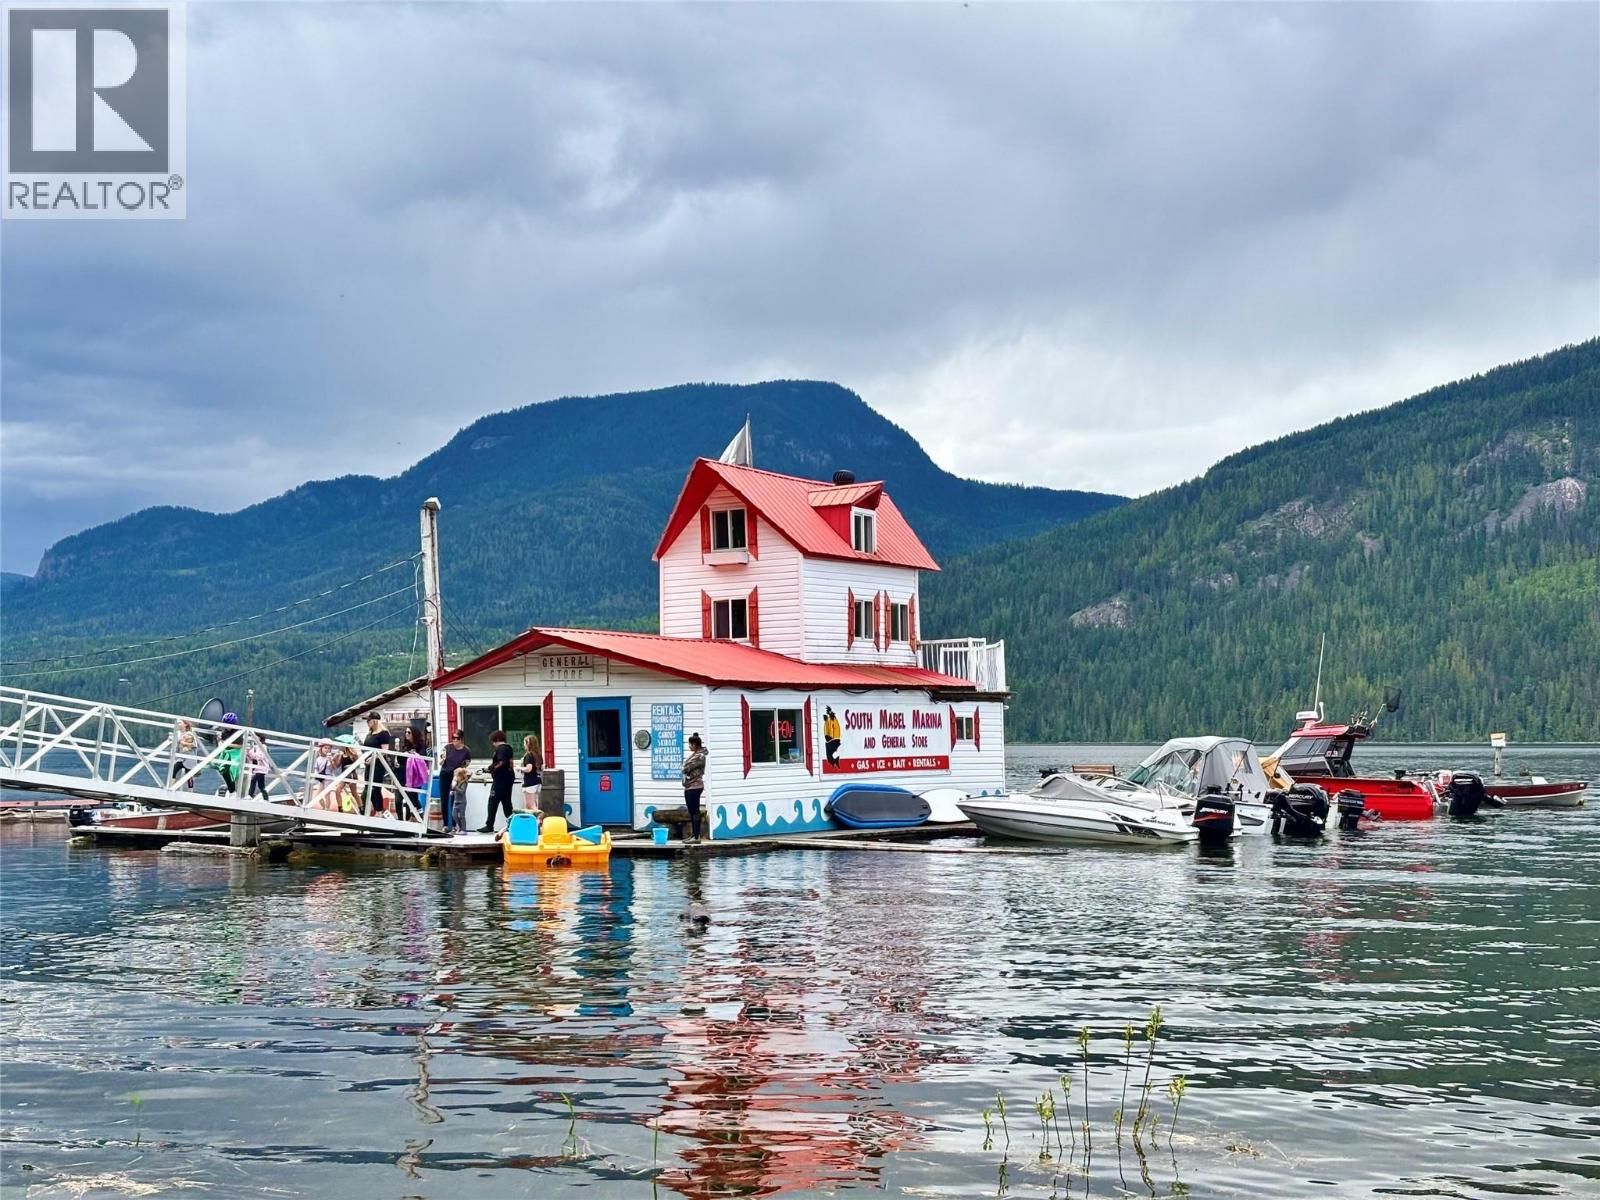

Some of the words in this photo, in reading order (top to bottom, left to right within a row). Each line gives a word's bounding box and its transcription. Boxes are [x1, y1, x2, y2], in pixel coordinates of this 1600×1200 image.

[542, 656, 590, 667] GENERAL
[550, 669, 583, 679] STORE
[652, 705, 682, 715] RENTALS
[845, 709, 872, 730] SOUTH
[880, 709, 906, 730] MABEL
[912, 709, 942, 729] MARINA
[864, 736, 875, 749] AND
[882, 735, 906, 748] GENERAL
[912, 734, 928, 748] STORE
[856, 760, 869, 769] GAS
[877, 760, 885, 769] ICE
[893, 759, 905, 768] BAIT
[912, 759, 936, 767] RENTALS
